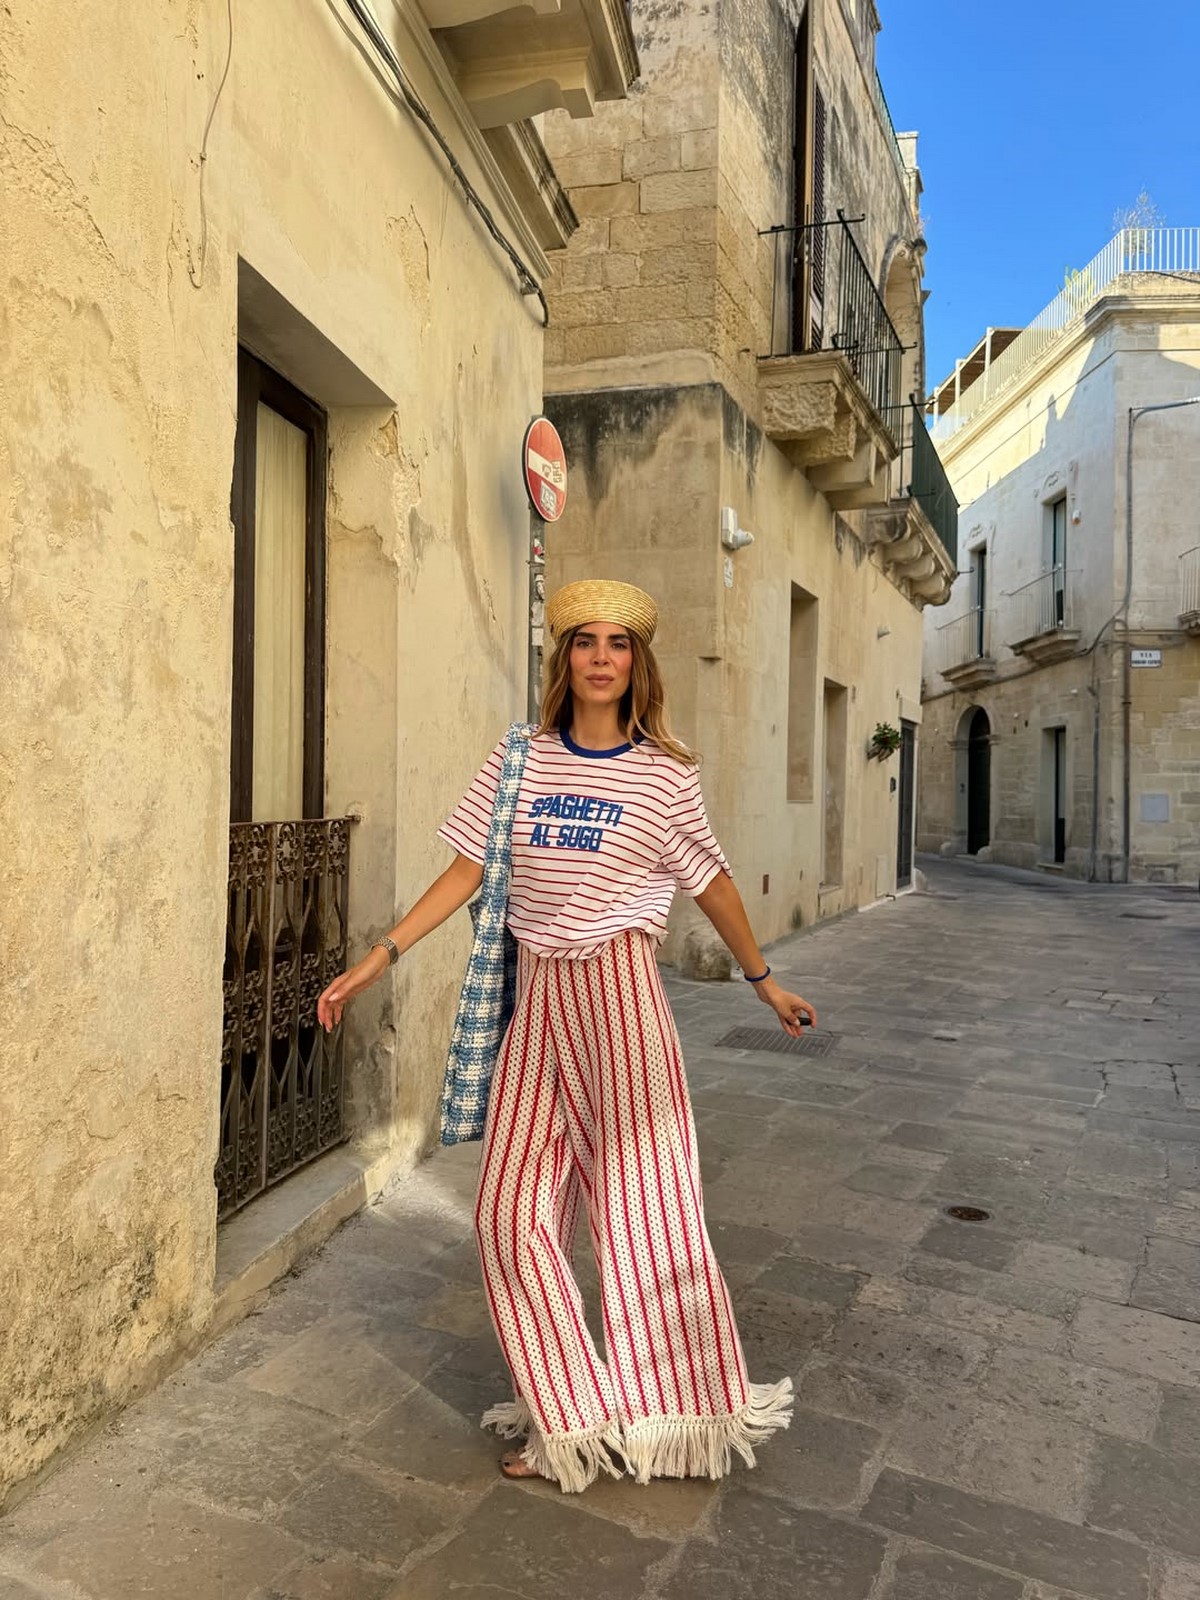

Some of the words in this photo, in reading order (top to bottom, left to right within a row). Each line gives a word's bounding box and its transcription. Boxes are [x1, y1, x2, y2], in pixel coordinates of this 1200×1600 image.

[528, 795, 623, 827] SPAGHETTI
[530, 823, 551, 846] AL
[556, 824, 603, 851] SUGO
